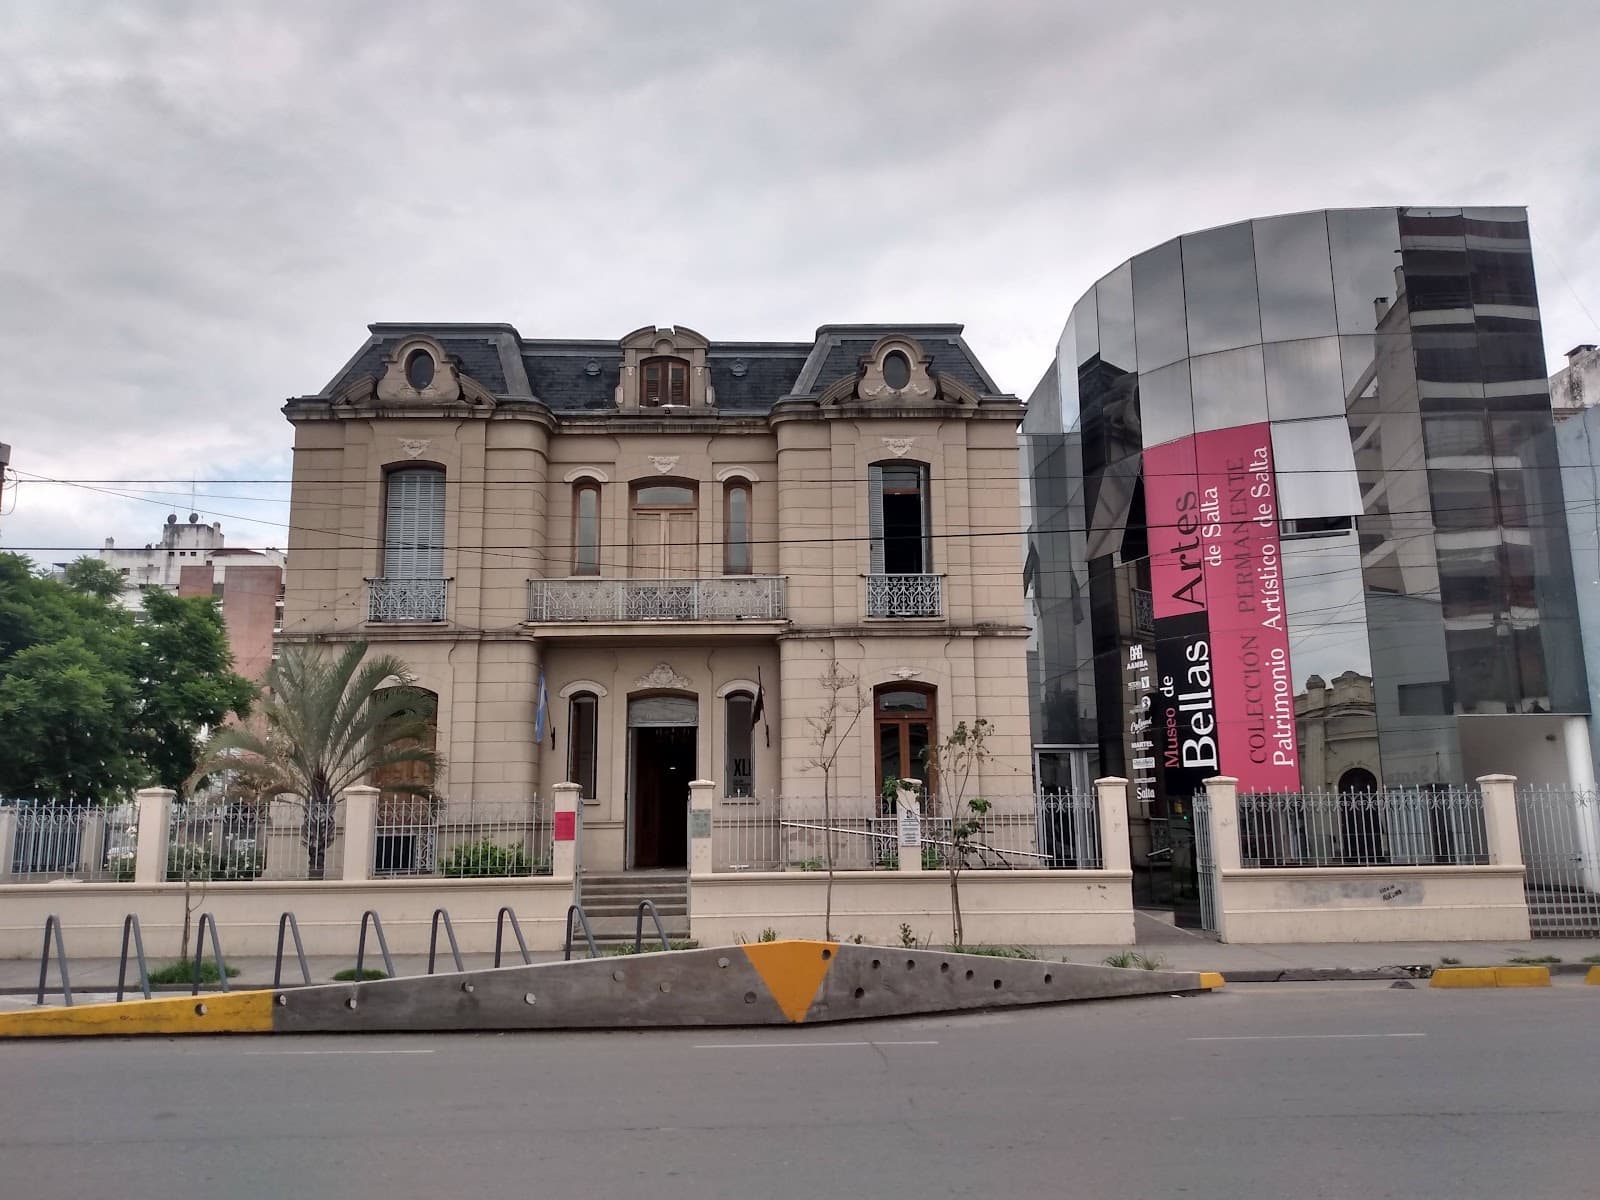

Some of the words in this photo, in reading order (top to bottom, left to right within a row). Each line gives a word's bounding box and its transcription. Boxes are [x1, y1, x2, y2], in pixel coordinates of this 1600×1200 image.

[1249, 446, 1271, 497] Salta
[1171, 491, 1205, 608] Artes
[1201, 487, 1221, 538] Salta
[1226, 457, 1255, 613] PERMANENTE
[1253, 503, 1273, 528] de
[1204, 545, 1222, 567] de
[1257, 544, 1282, 631] Artístico
[1160, 675, 1174, 697] de
[1178, 641, 1218, 770] Bellas
[1239, 636, 1267, 764] COLECCIÓN
[1265, 648, 1294, 767] Patrimonio
[1165, 707, 1179, 768] Museo
